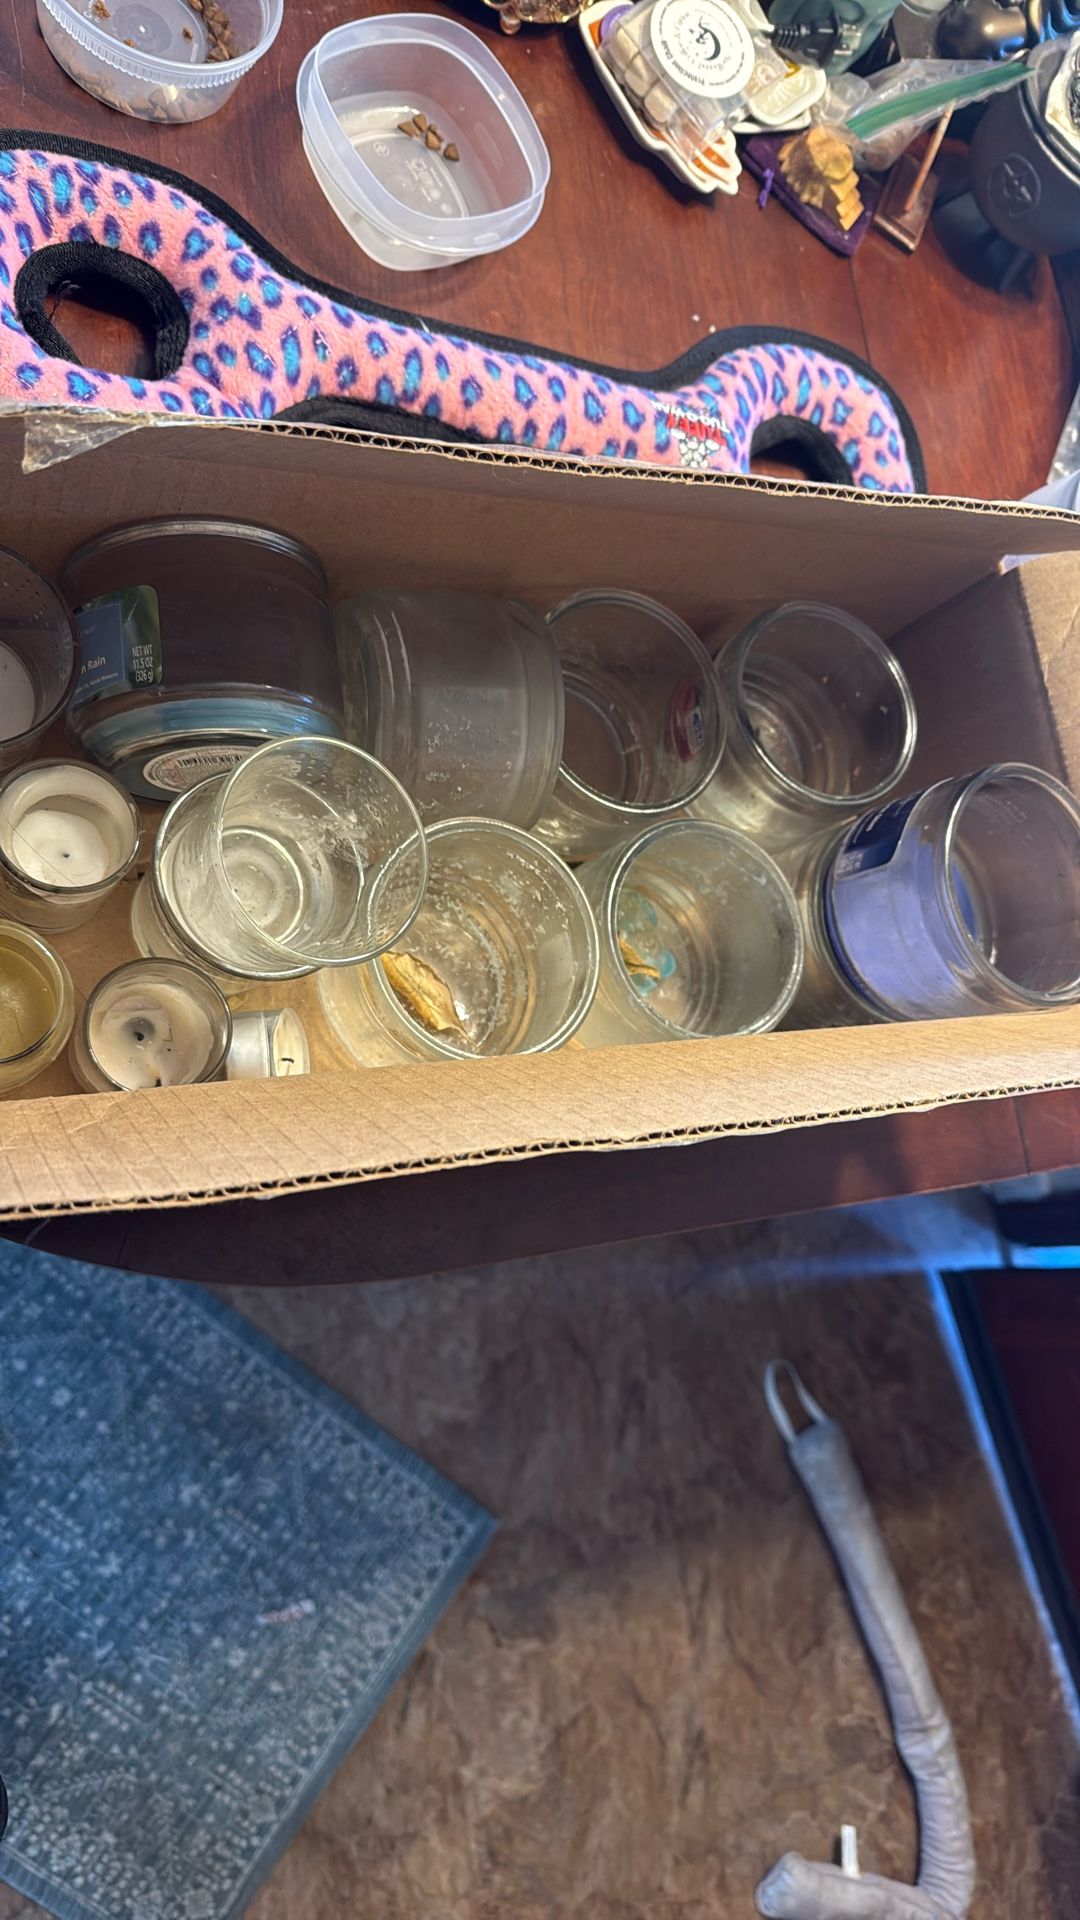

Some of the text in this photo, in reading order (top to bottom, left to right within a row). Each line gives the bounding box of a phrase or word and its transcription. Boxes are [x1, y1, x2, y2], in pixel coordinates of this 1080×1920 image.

[132, 643, 153, 657] NET WT
[87, 656, 106, 670] Rain
[132, 656, 154, 670] 11.5 OZ
